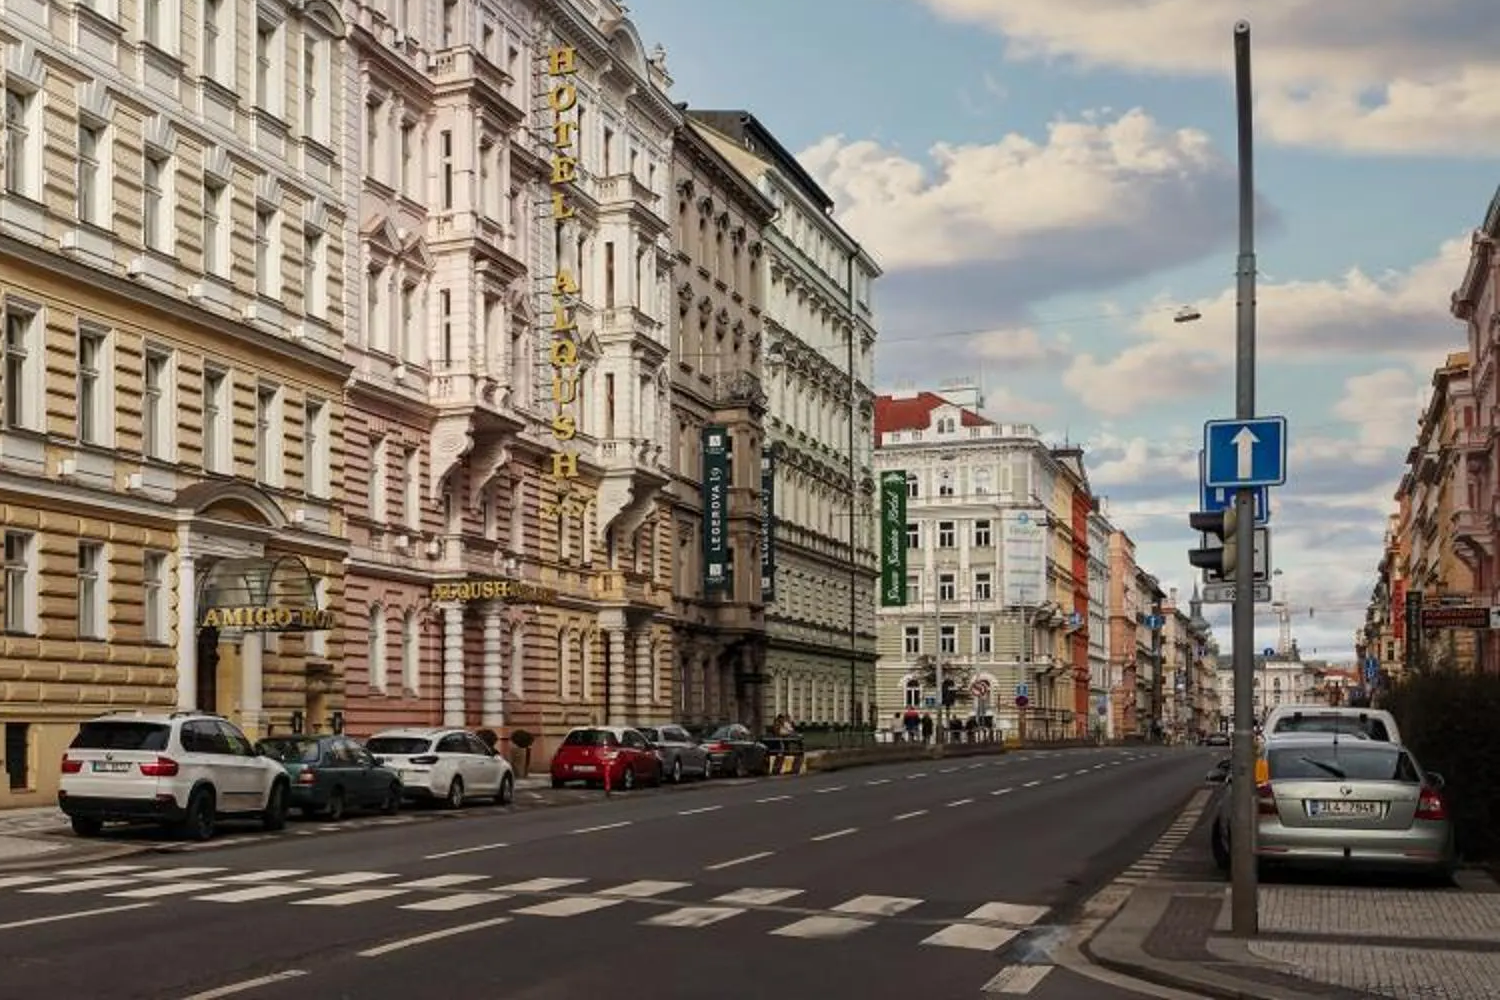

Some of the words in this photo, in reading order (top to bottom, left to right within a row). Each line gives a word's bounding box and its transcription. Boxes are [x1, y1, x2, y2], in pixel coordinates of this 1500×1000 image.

[549, 47, 579, 220] HOTEL
[551, 268, 581, 479] ALQUSH
[202, 605, 293, 627] AMIGO
